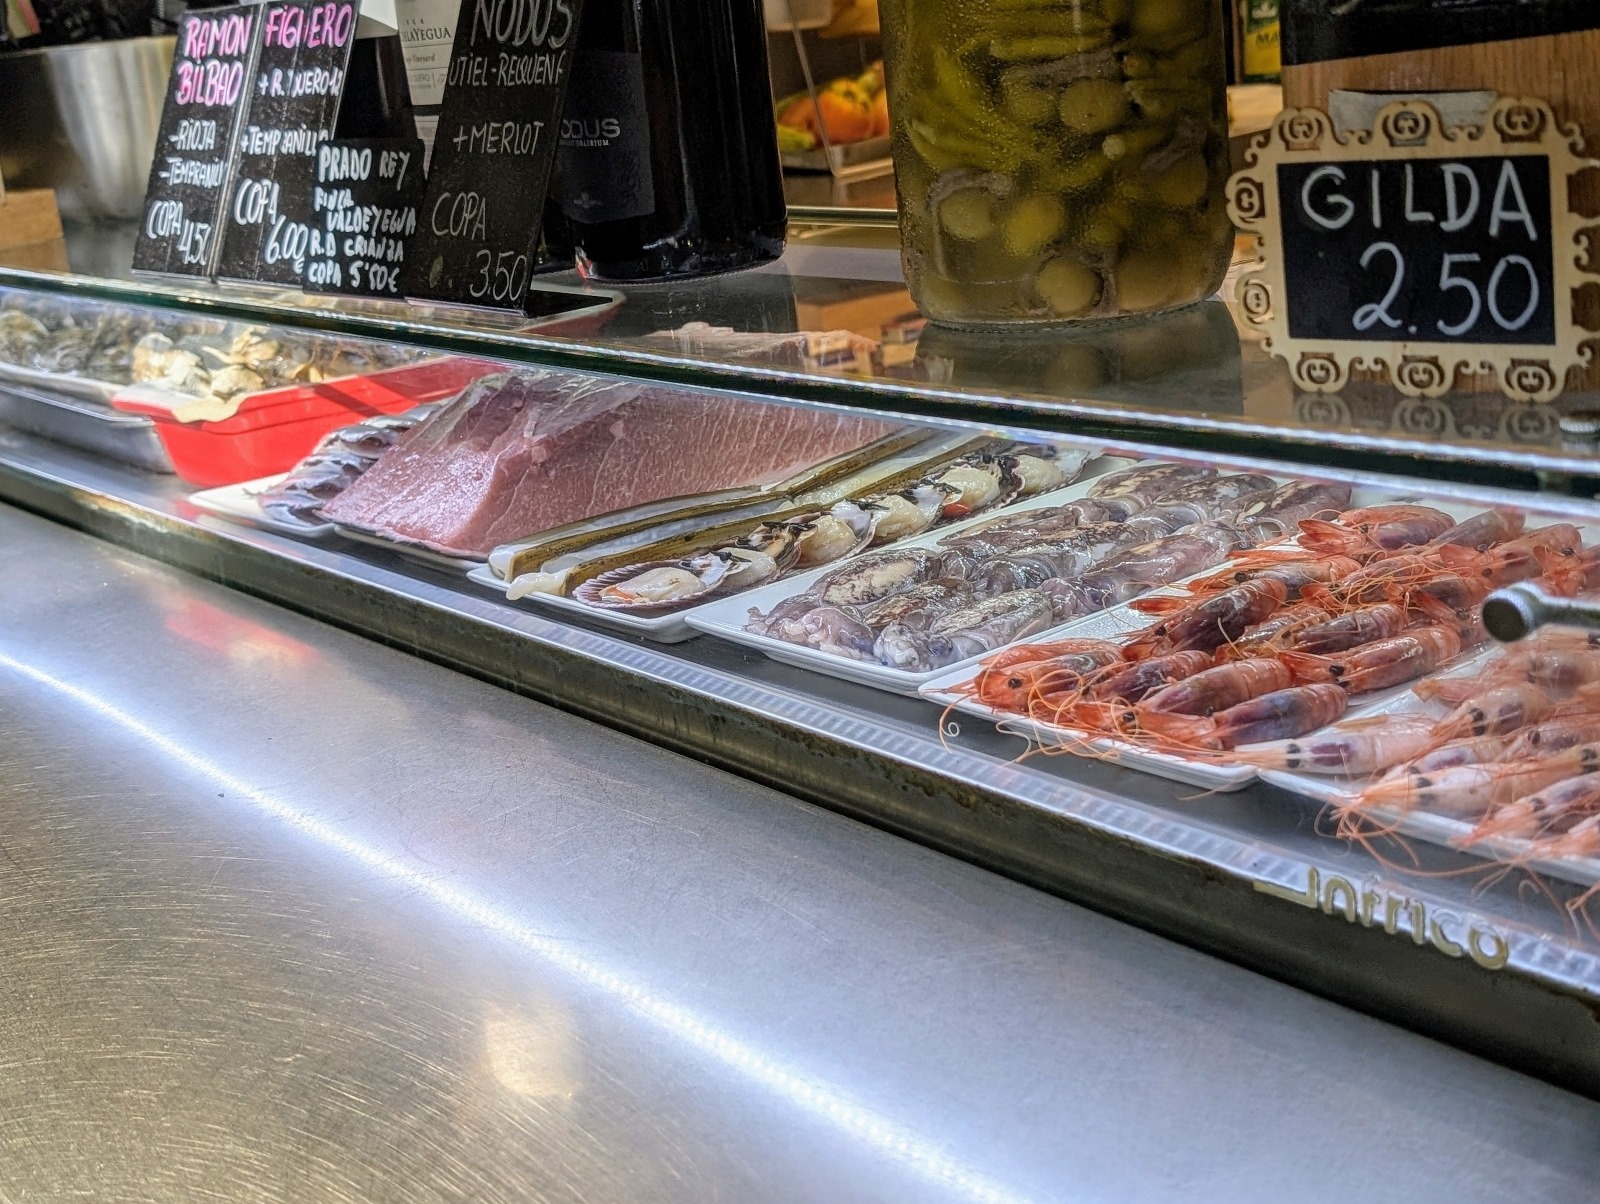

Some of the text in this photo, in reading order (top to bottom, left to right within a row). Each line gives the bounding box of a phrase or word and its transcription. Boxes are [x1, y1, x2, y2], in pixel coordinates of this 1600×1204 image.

[184, 14, 252, 60] RAMON
[470, 0, 573, 49] NODUS
[176, 59, 244, 106] BILBAO
[560, 118, 621, 138] ODUS
[318, 144, 411, 191] PRADO REY
[146, 200, 183, 240] COPA
[234, 178, 280, 225] COPA
[313, 186, 355, 212] FINCA
[326, 205, 417, 237] VALDEYEGUA
[432, 191, 487, 241] COPA
[1302, 158, 1538, 242] GILDA
[343, 234, 404, 263] CRIANZA
[307, 259, 342, 288] COPA
[1352, 241, 1540, 336] 2.50
